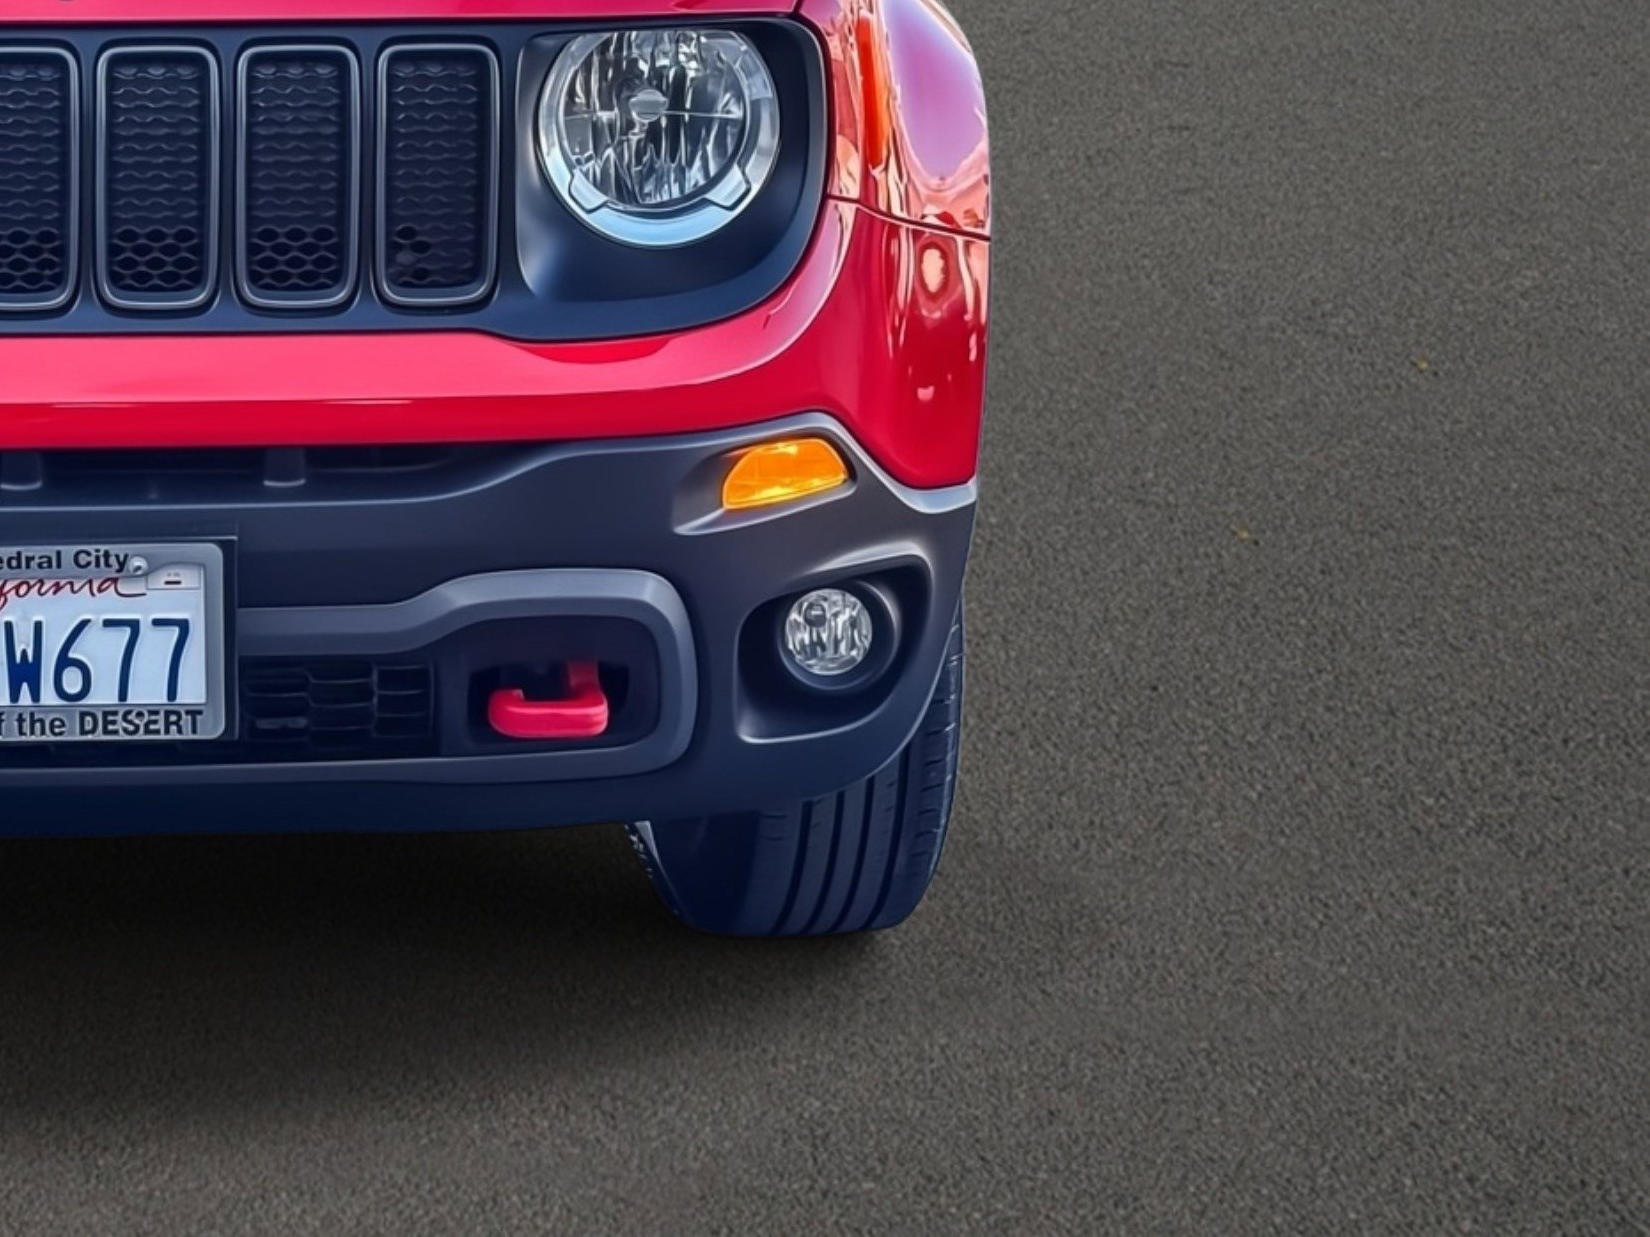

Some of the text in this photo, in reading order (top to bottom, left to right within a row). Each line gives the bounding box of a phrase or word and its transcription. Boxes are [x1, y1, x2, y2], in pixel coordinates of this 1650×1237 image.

[72, 548, 130, 574] City
[16, 711, 67, 737] the
[78, 708, 204, 736] DESERT
